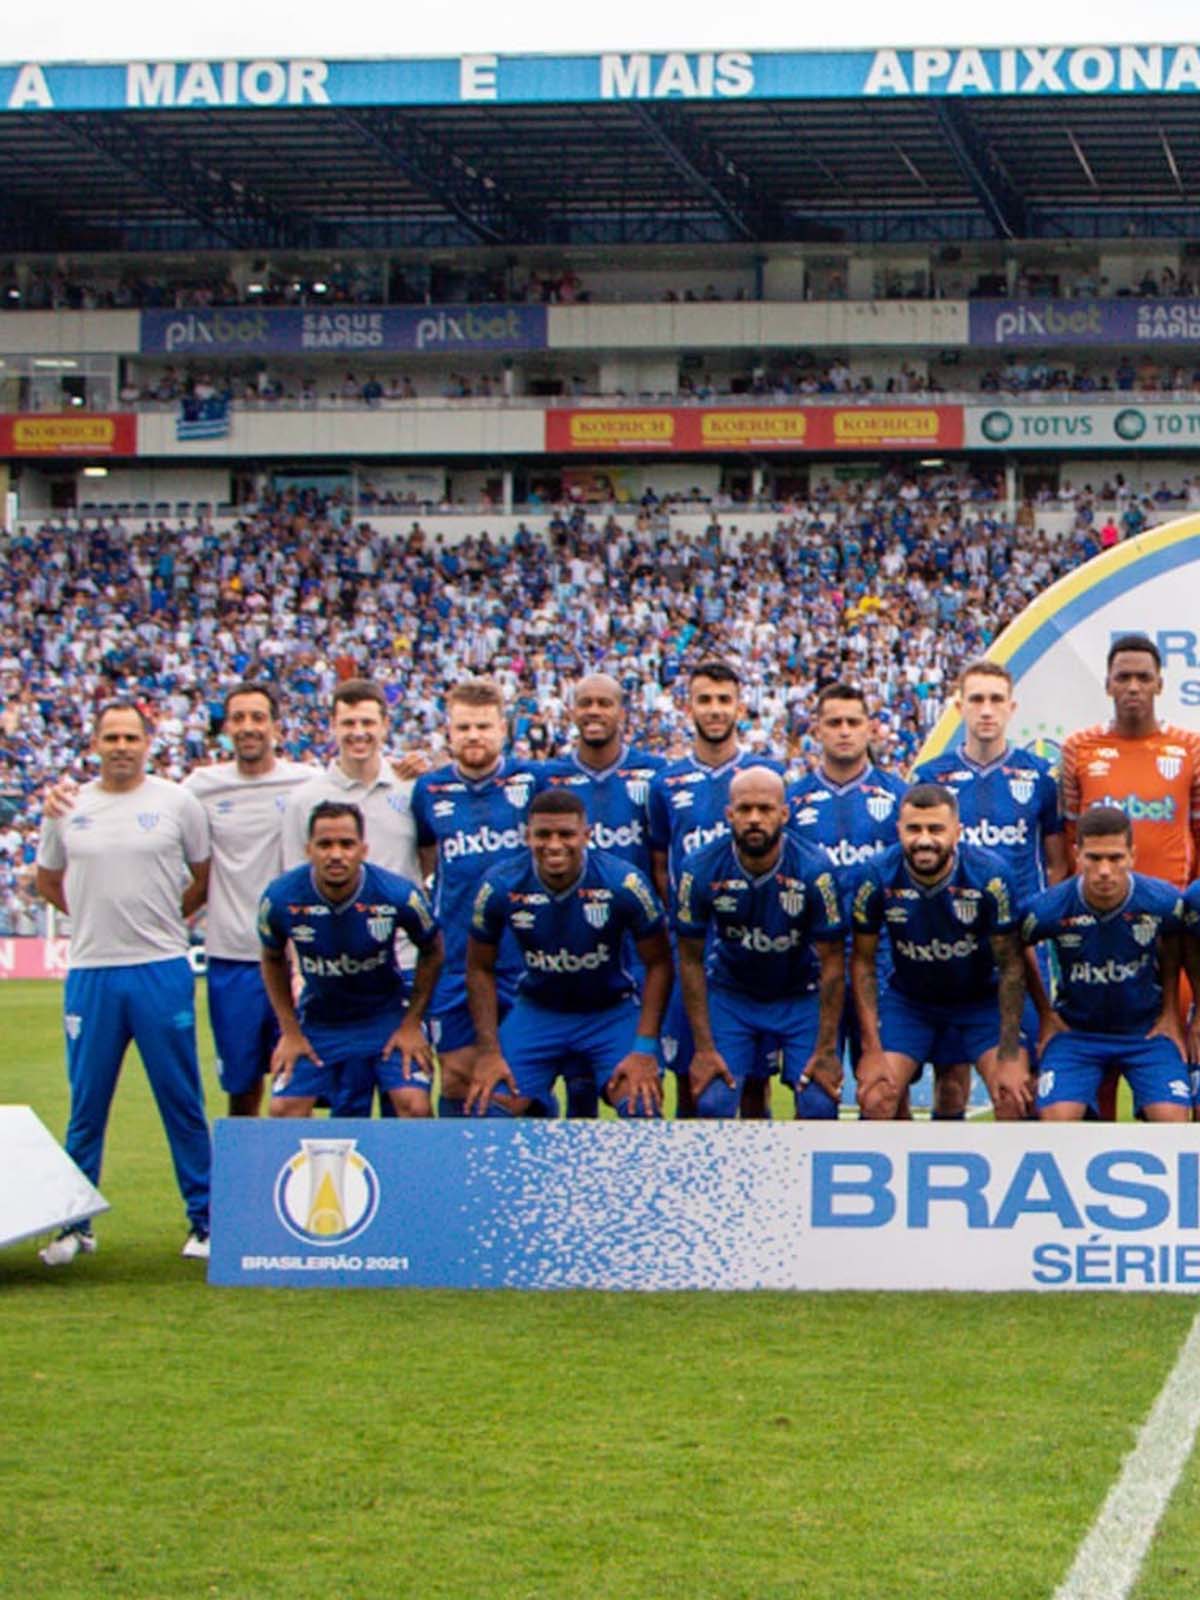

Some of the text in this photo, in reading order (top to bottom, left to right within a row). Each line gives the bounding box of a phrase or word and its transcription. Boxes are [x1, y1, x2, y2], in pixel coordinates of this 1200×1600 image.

[11, 64, 54, 108] A
[125, 59, 331, 105] MAIOR
[460, 56, 498, 99] E
[601, 53, 754, 98] MAIS
[165, 314, 268, 351] pixbet
[302, 314, 384, 331] SAQUE
[416, 311, 520, 349] pixbet
[996, 303, 1102, 342] pixbet
[1021, 415, 1093, 436] TOTVS
[242, 1254, 410, 1271] BRASILEIRÃO 2021
